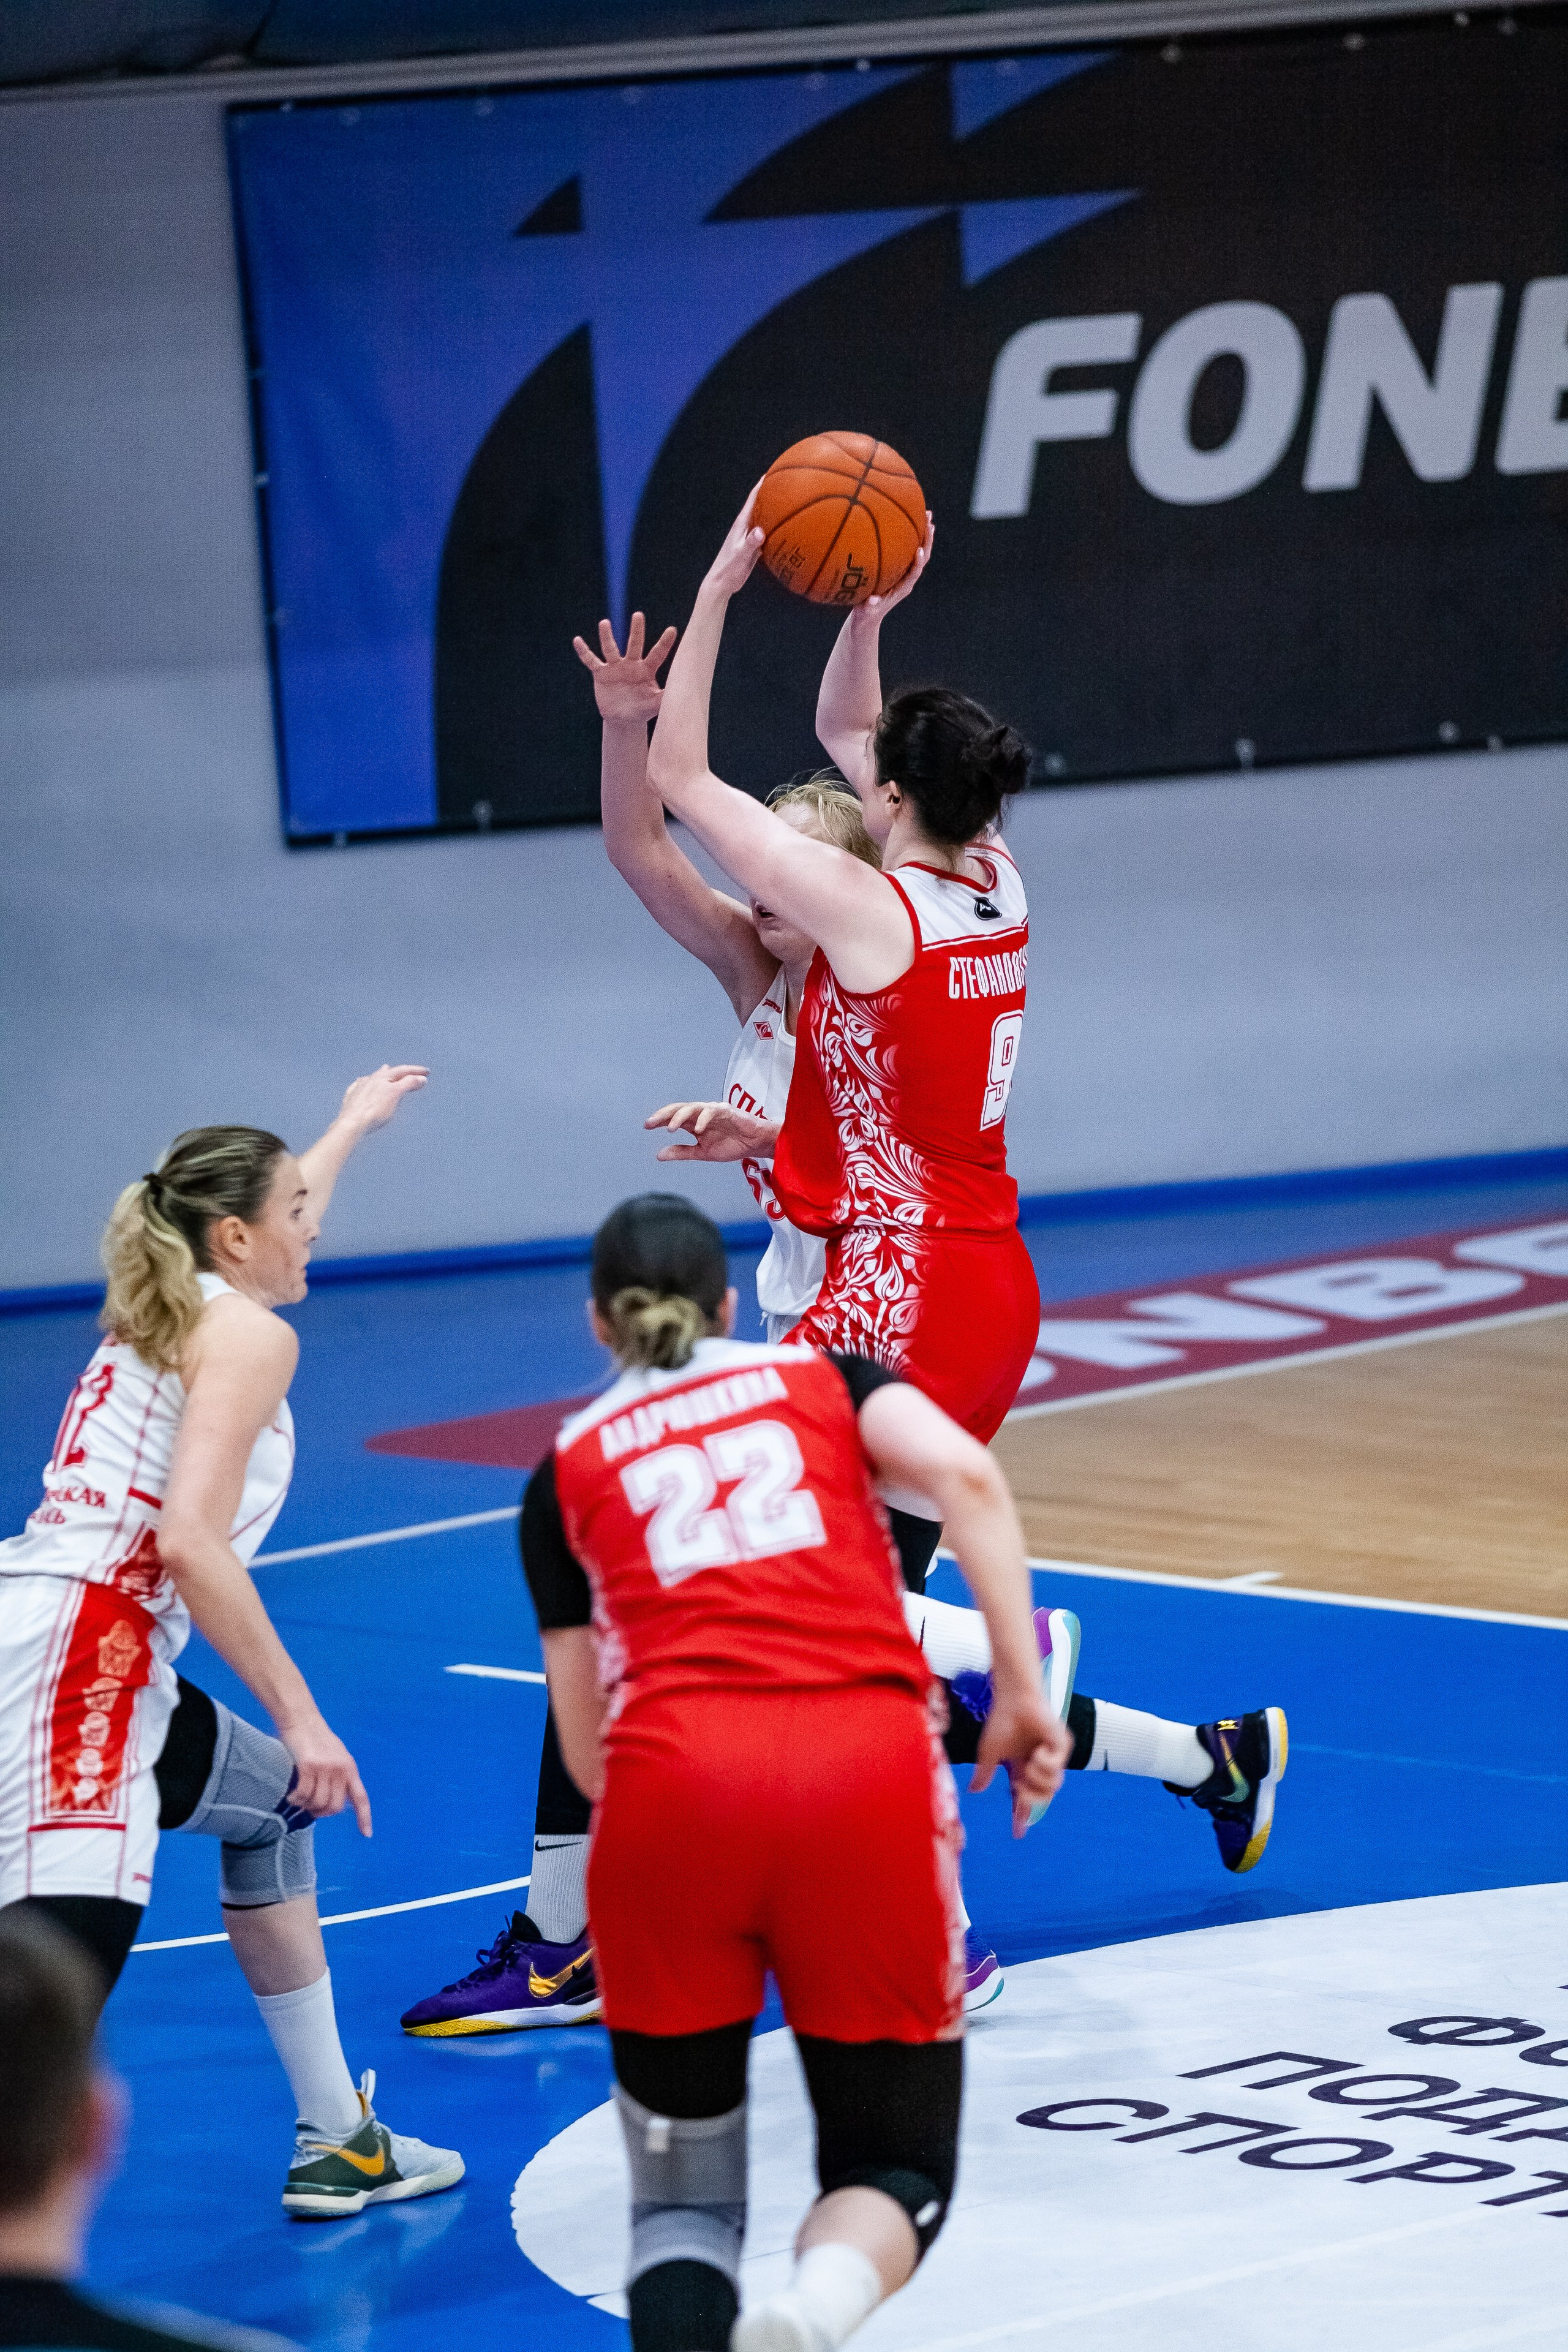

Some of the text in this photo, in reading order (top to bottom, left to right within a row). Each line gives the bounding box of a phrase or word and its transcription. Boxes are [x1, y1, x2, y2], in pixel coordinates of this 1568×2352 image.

[980, 1009, 1024, 1132] 9
[619, 1419, 827, 1589] 22
[1016, 2098, 1568, 2217] СПОРТ
